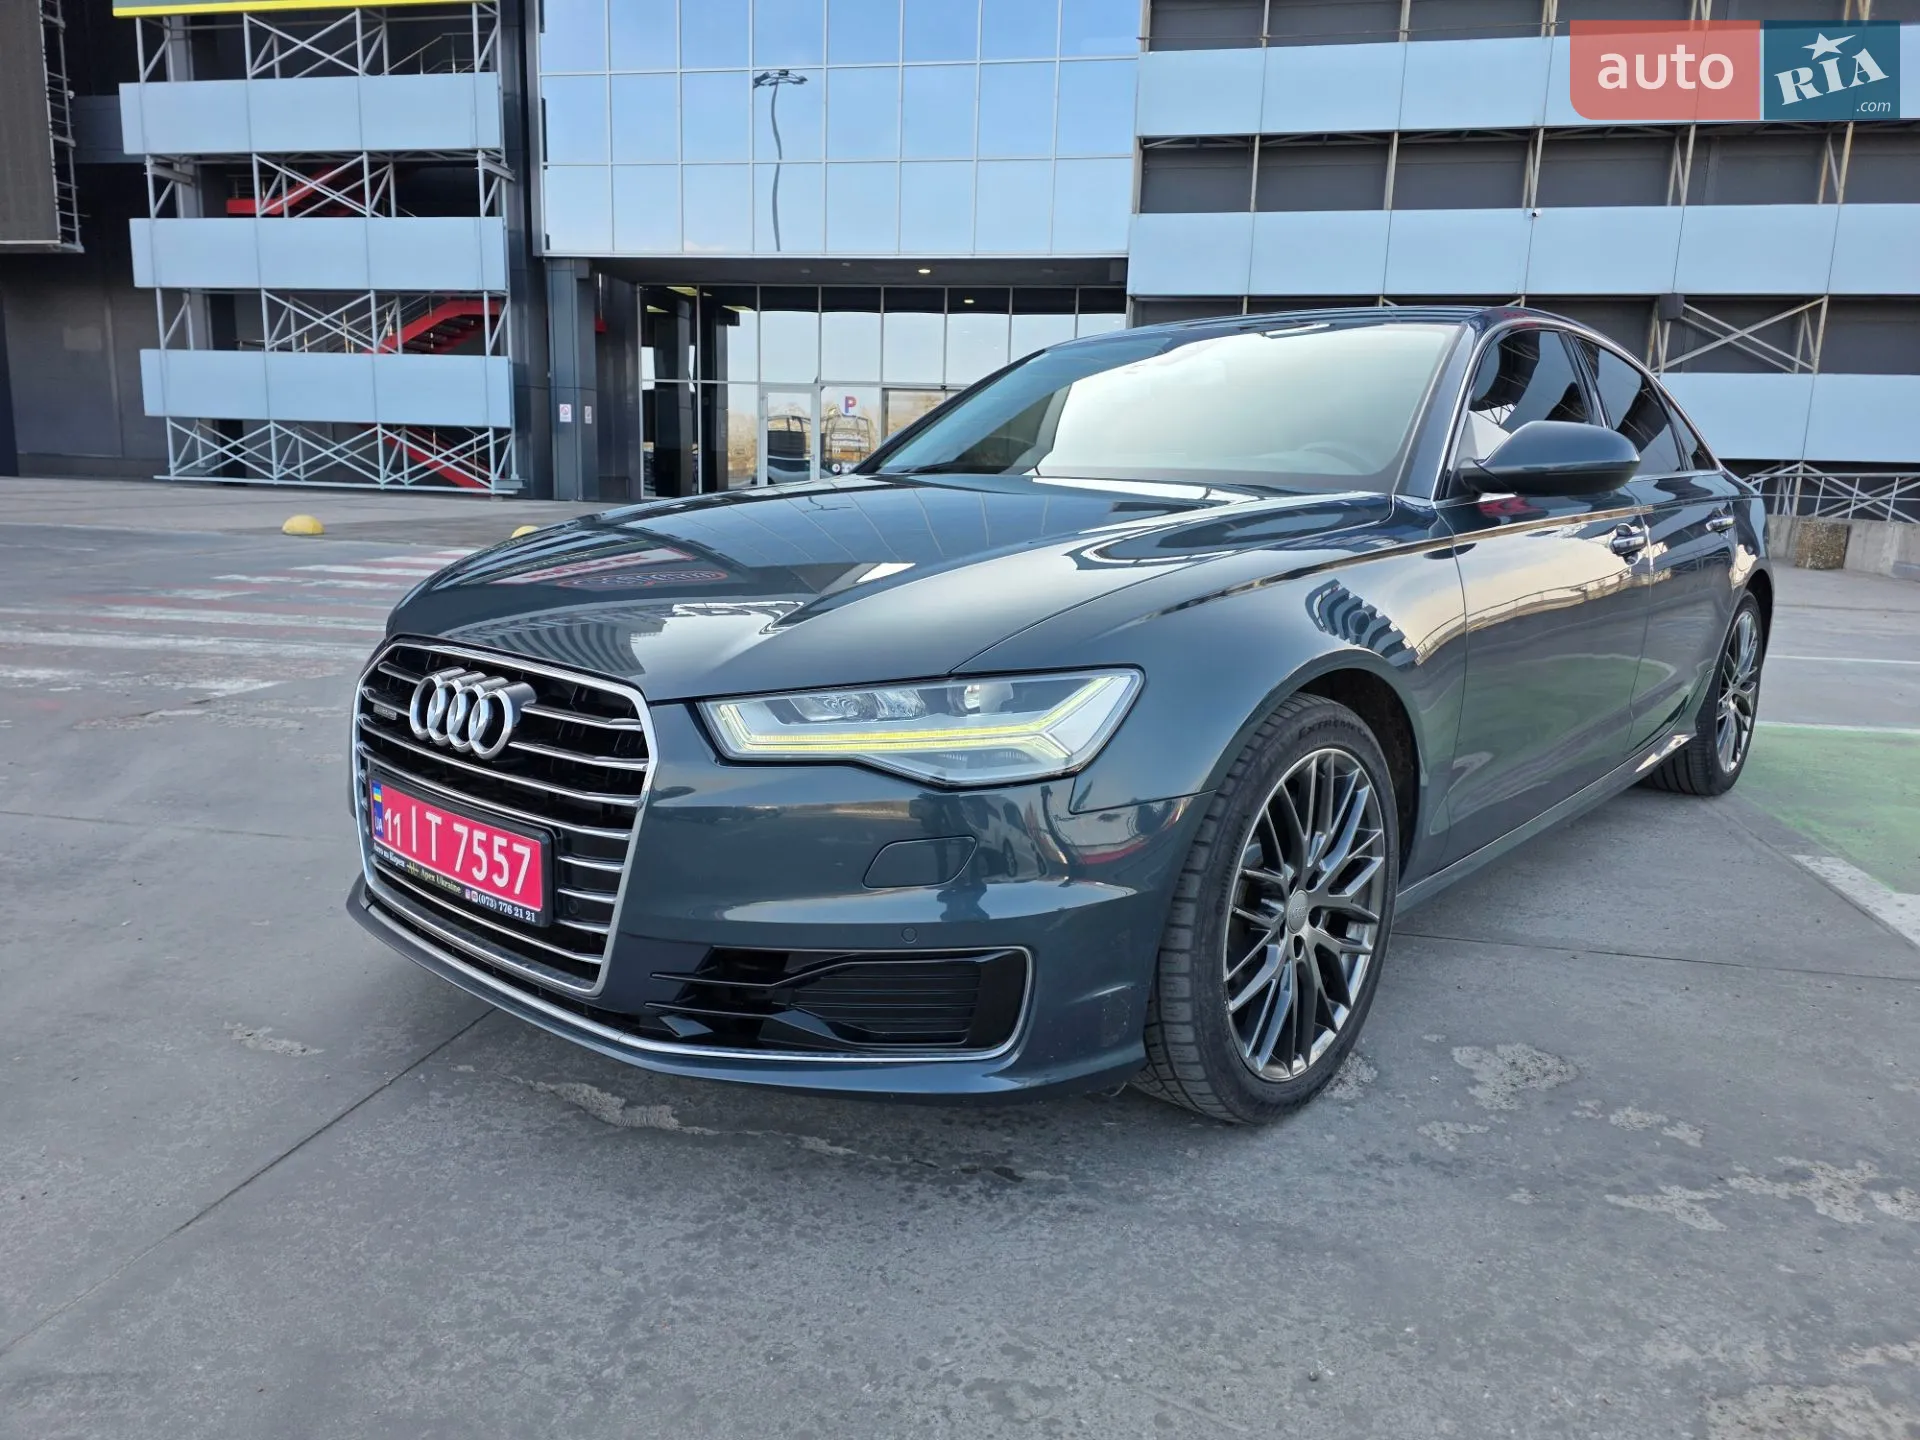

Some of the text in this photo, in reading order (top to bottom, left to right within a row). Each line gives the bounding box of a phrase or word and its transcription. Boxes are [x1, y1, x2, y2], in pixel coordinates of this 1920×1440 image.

[844, 395, 857, 414] P
[384, 805, 531, 895] 11 IT 7557
[478, 893, 536, 923] (073) 776 21 21
